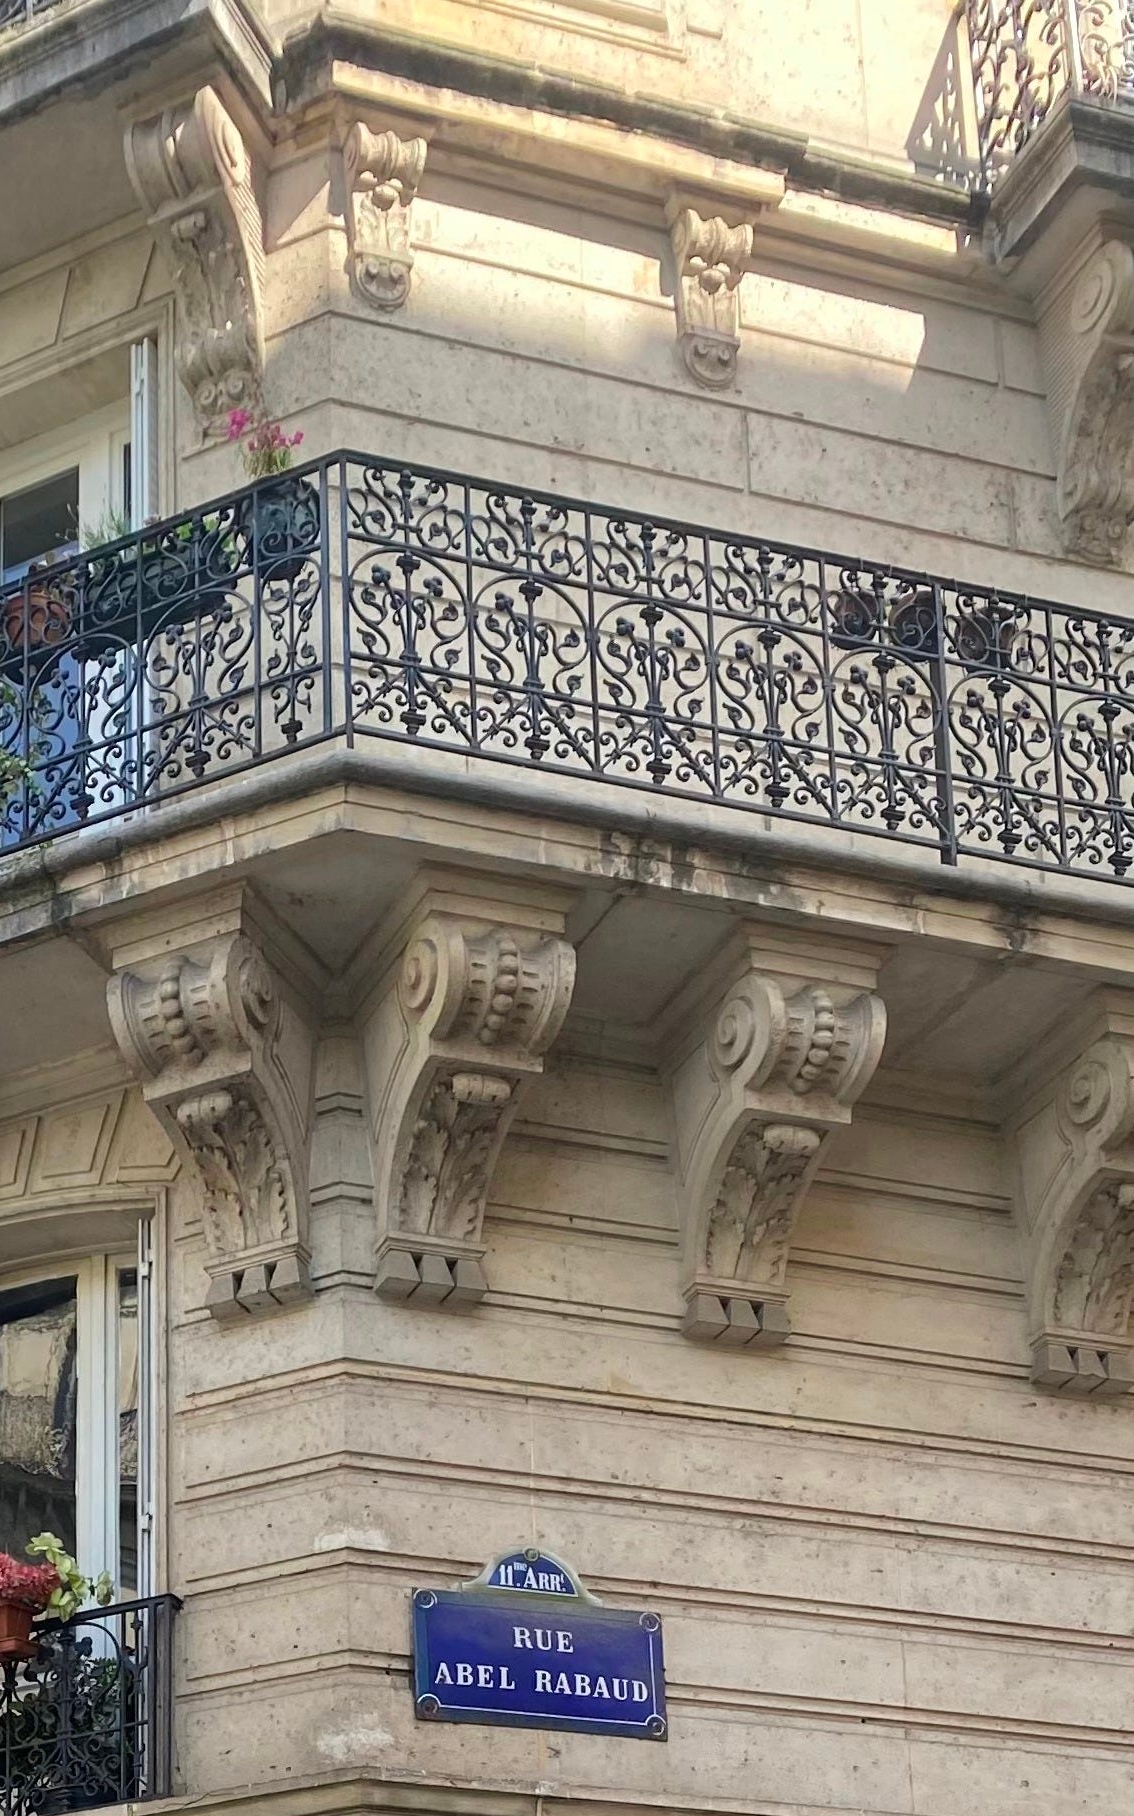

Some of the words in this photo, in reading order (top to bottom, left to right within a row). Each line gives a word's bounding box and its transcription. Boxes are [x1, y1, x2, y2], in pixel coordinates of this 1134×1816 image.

[513, 1626, 574, 1653] RUE
[434, 1662, 516, 1690] ABEL
[534, 1669, 649, 1703] RABAUD
